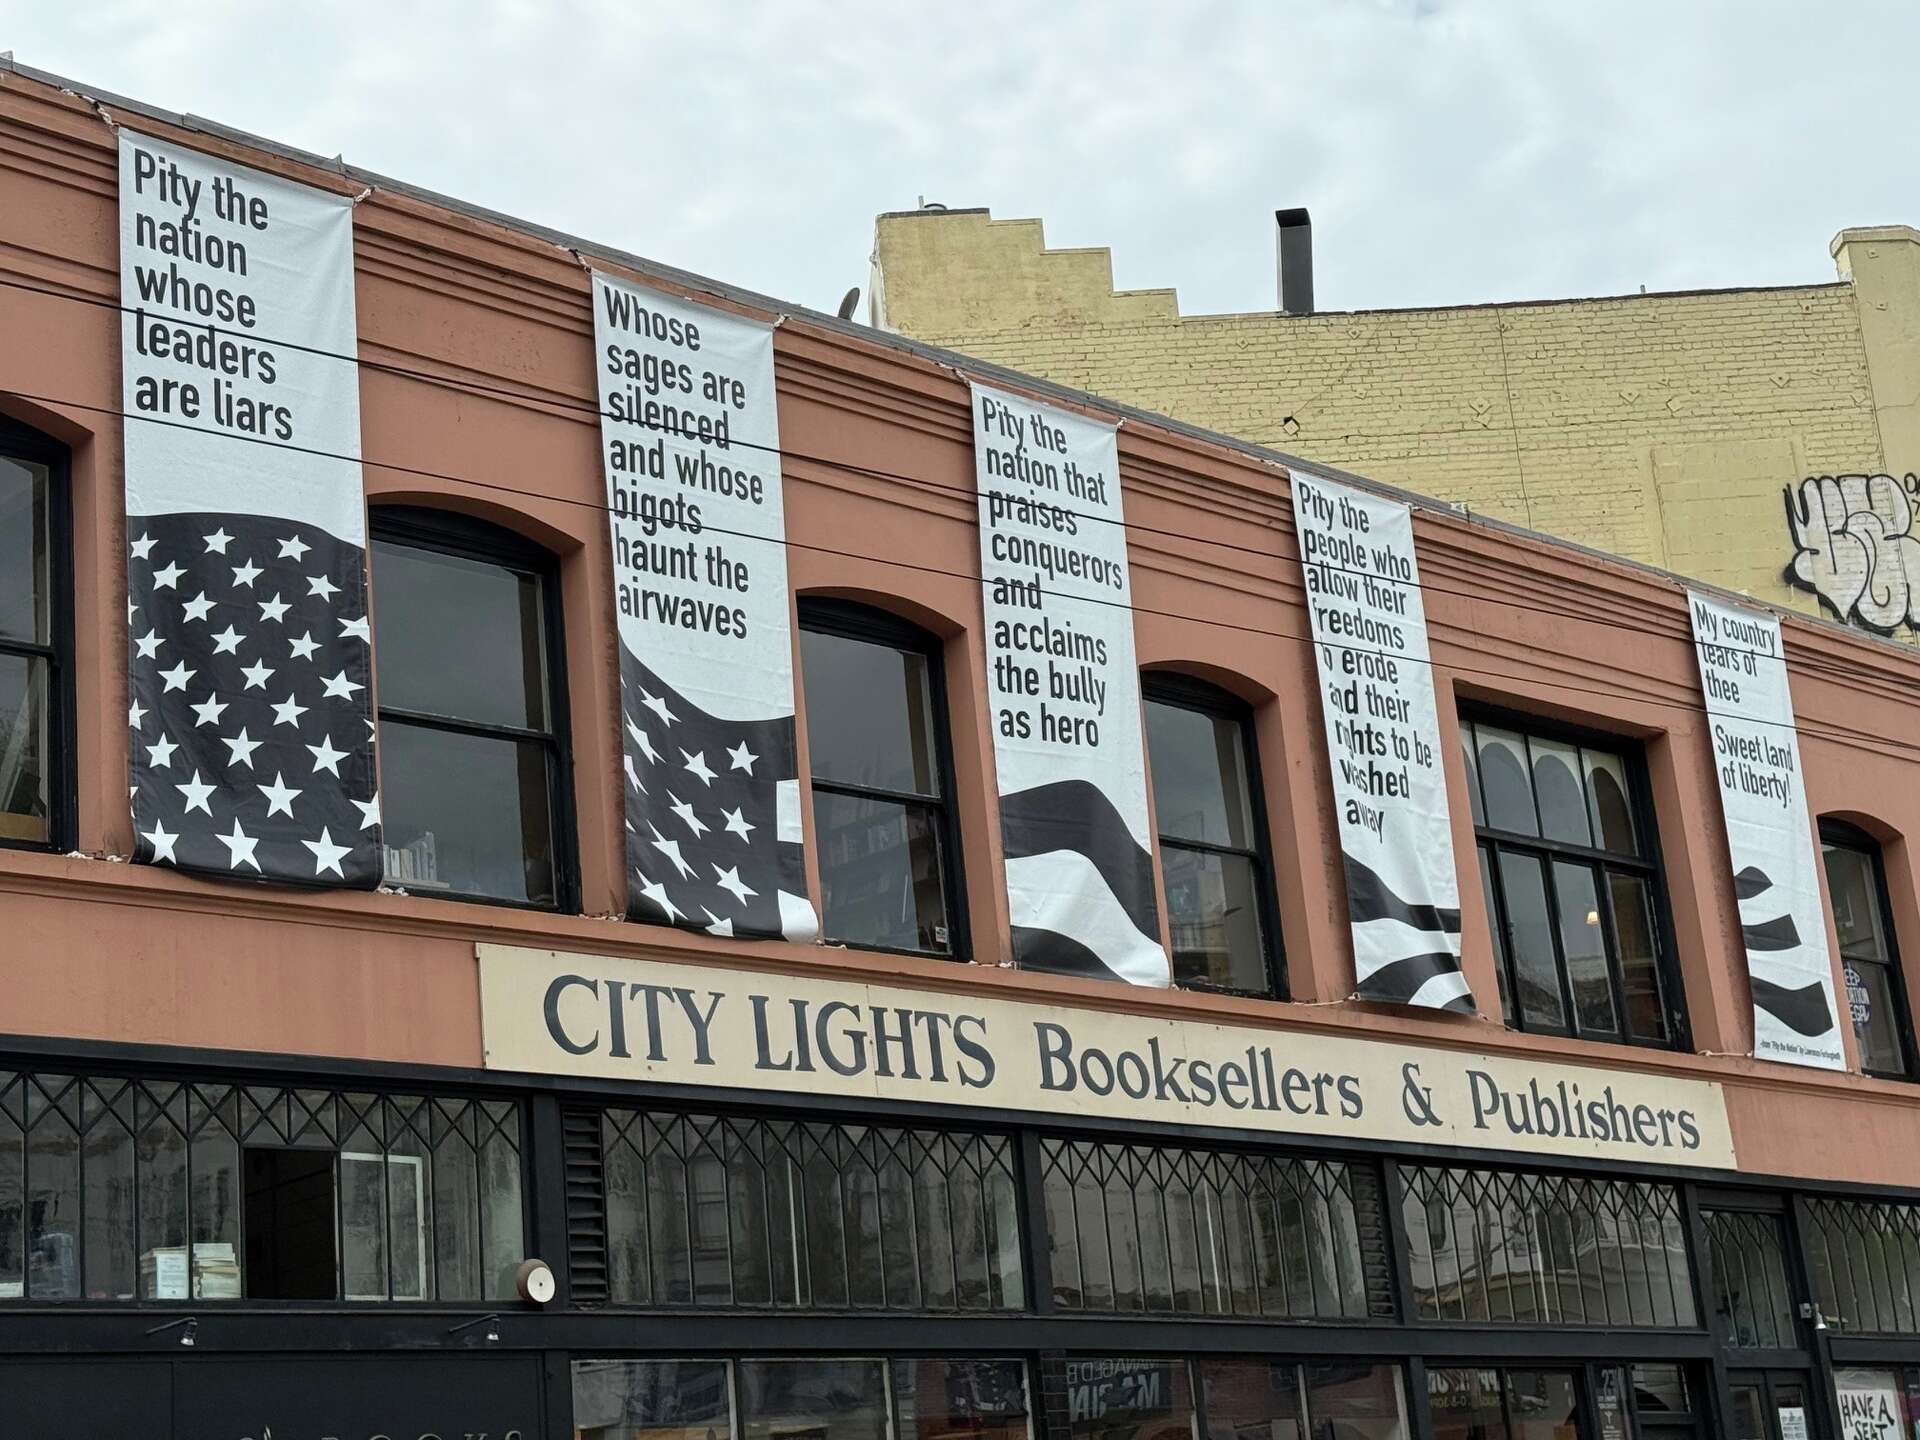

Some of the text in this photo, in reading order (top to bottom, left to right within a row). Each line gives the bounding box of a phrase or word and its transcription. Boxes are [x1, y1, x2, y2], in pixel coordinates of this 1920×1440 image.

[134, 148, 268, 230] Pity the
[136, 212, 247, 276] nation
[134, 262, 256, 328] whose
[604, 285, 700, 352] Whose
[136, 308, 276, 385] leaders
[607, 344, 745, 410] sages are
[135, 375, 293, 441] are liars
[608, 384, 730, 450] silenced
[982, 396, 1067, 455] Pity the
[610, 438, 763, 505] and whose
[986, 446, 1108, 506] nation that
[612, 475, 702, 536] bigots
[989, 489, 1078, 536] praises
[1298, 481, 1370, 534] Pity the
[615, 523, 749, 593] haunt the
[992, 533, 1123, 591] conquerors
[1303, 528, 1411, 582] people who
[619, 576, 747, 639] airwaves
[992, 573, 1042, 610] and
[1308, 561, 1407, 616] allow their
[994, 617, 1108, 667] acclaims
[1694, 601, 1775, 657] My country
[1700, 636, 1758, 677] tears of
[994, 655, 1106, 717] the bully
[1342, 648, 1399, 685] erode
[1705, 669, 1741, 704] thee
[999, 703, 1100, 748] as hero
[1365, 684, 1411, 725] their
[1335, 714, 1432, 769] rghts to be
[1715, 724, 1794, 773] Sweet land
[1722, 761, 1792, 809] of liberty!
[543, 973, 1701, 1151] CITY LIGHTS Booksellers & Publishers
[1840, 1393, 1875, 1428] HAVE
[1879, 1394, 1895, 1426] A
[1854, 1420, 1888, 1440] SEAT
